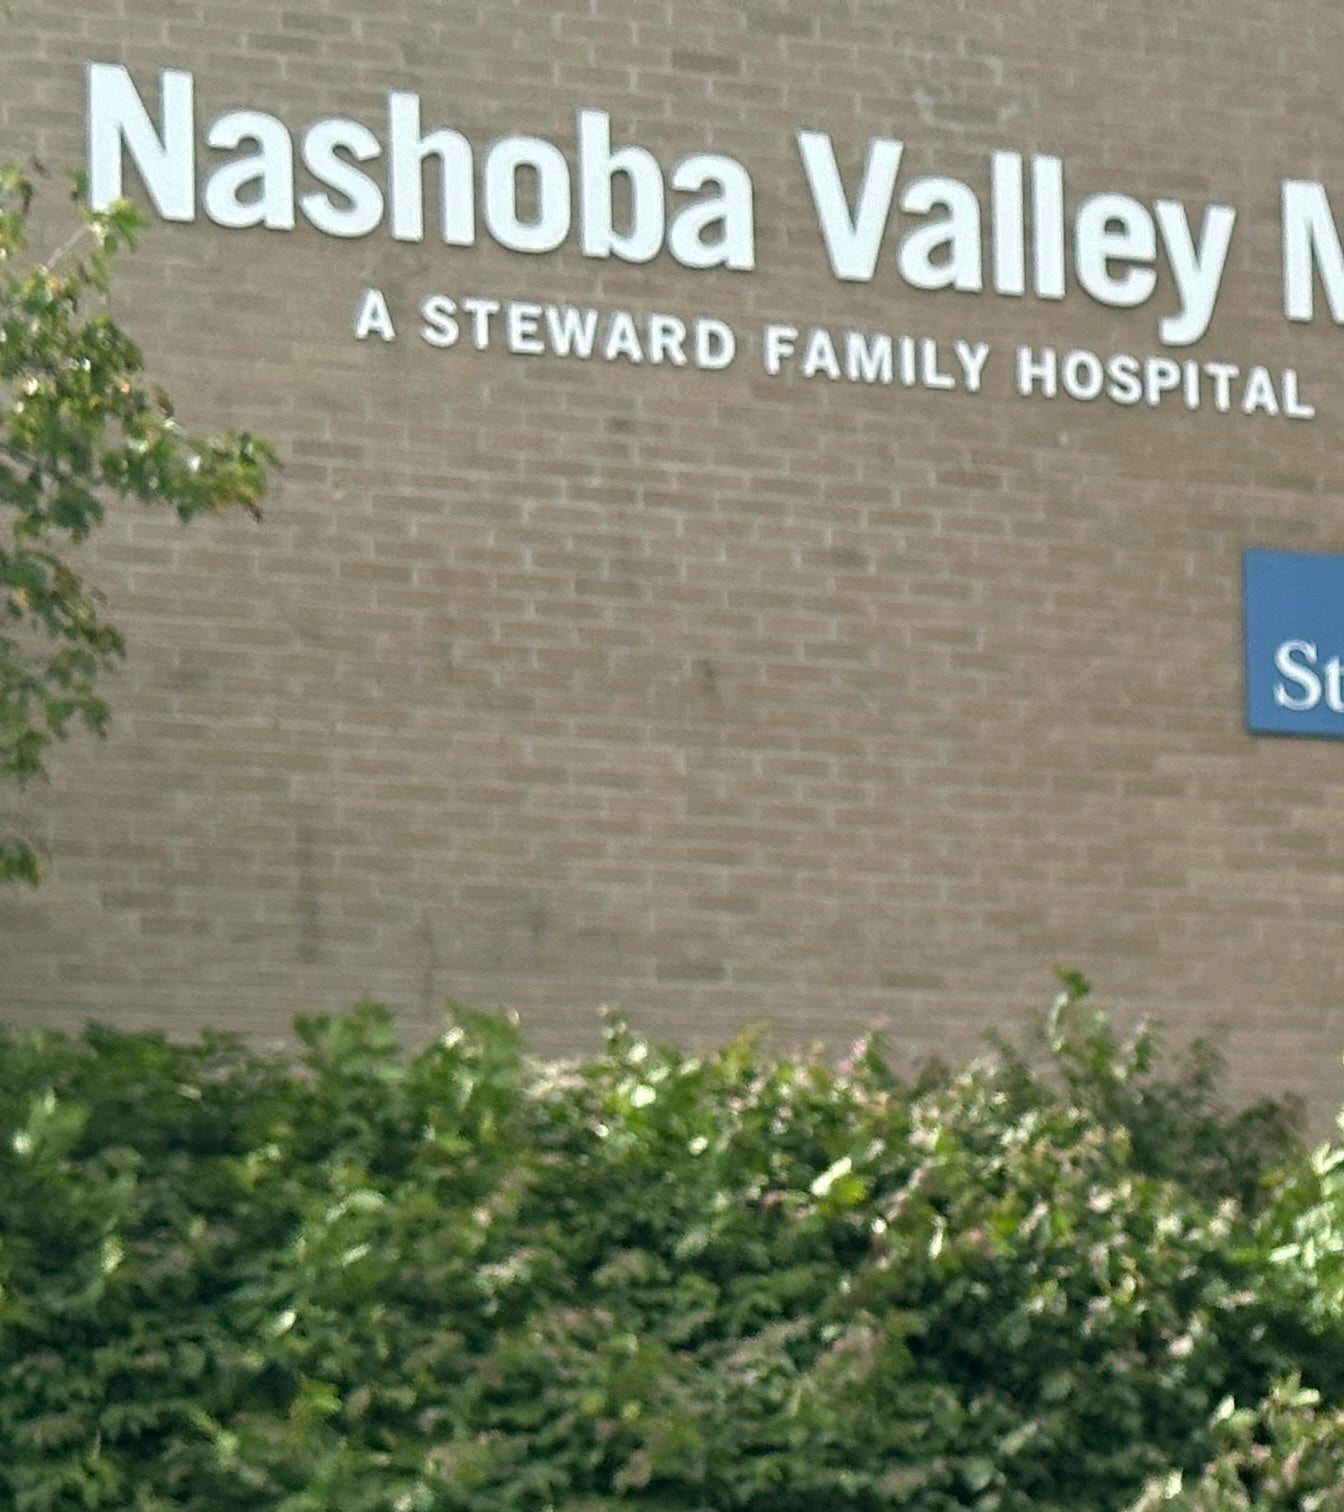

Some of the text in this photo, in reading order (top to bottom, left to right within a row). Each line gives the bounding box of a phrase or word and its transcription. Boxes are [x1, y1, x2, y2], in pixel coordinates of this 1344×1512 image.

[85, 60, 757, 272] Nashoba
[796, 130, 1238, 346] Valley
[353, 287, 1316, 419] A STEWARD FAMILY HOSPITAL
